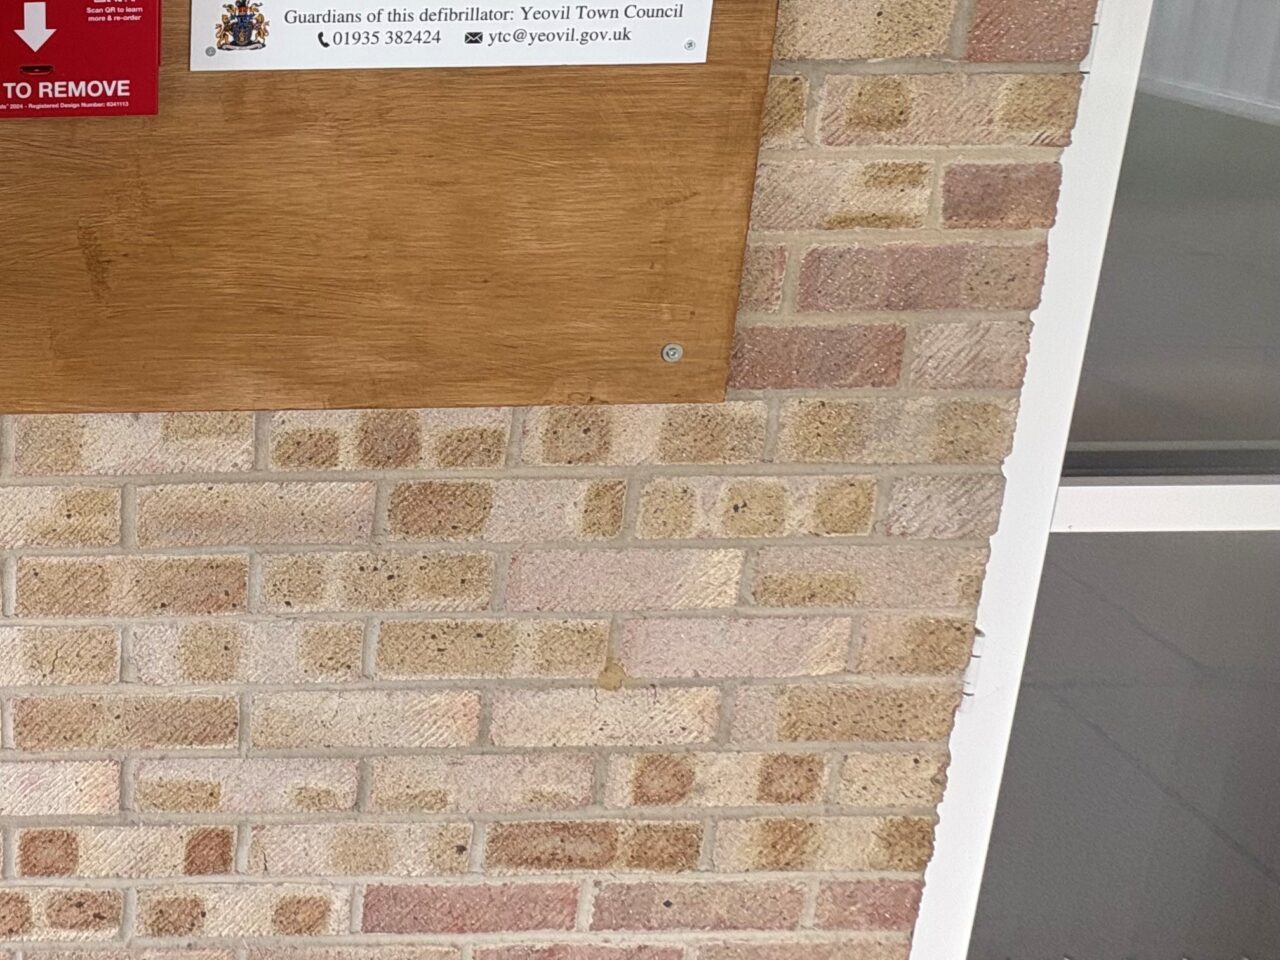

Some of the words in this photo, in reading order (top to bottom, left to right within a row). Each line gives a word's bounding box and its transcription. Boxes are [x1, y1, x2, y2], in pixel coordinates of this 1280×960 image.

[87, 6, 103, 14] Scan
[105, 6, 115, 14] QR
[107, 14, 112, 22] &
[285, 10, 361, 23] Guardians
[367, 9, 384, 22] of
[388, 9, 414, 22] this
[419, 8, 513, 21] defibrillator:
[521, 6, 570, 20] Yeovil
[576, 6, 618, 19] Town
[624, 4, 683, 18] Council
[332, 30, 380, 46] 01935
[384, 29, 441, 45] 382424
[488, 27, 631, 46] ytc@yeovil.gov.uk
[3, 82, 31, 98] TO
[39, 80, 130, 97] REMOVE
